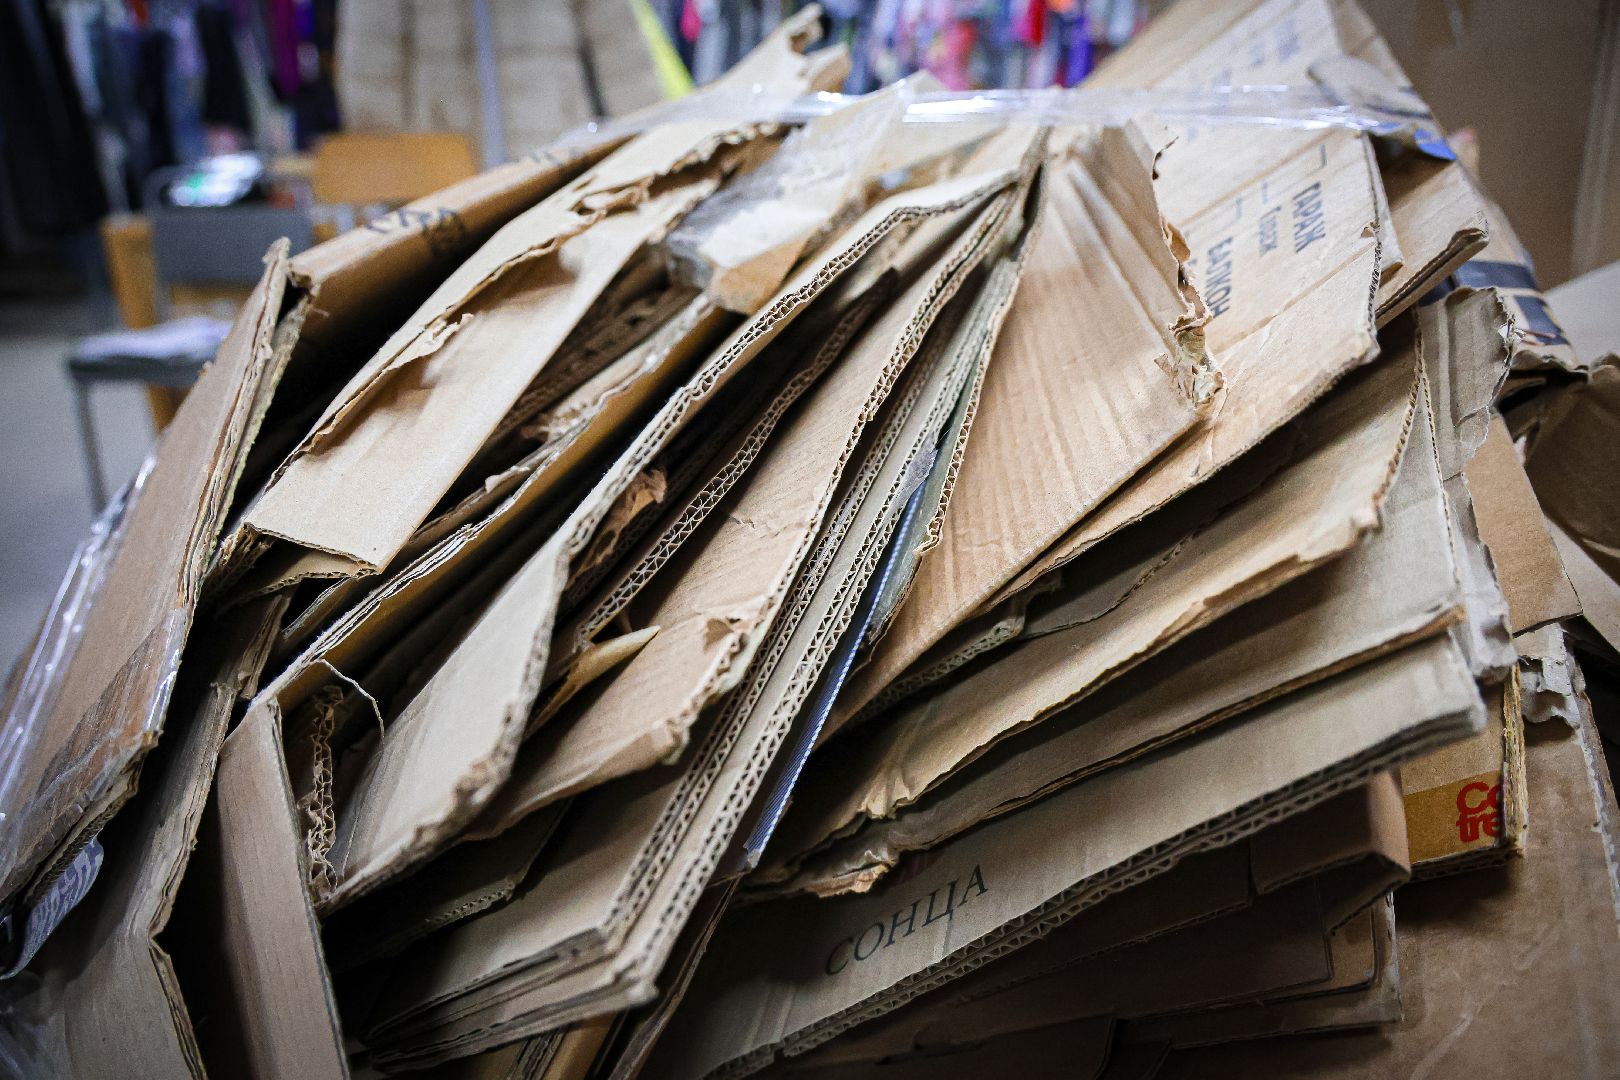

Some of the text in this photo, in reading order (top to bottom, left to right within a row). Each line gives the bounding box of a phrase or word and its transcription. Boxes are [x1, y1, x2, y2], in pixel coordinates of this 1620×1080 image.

[1293, 181, 1326, 254] ГАРАЖ
[1205, 237, 1234, 318] БАЛКОН
[826, 864, 988, 975] СОНЦА
